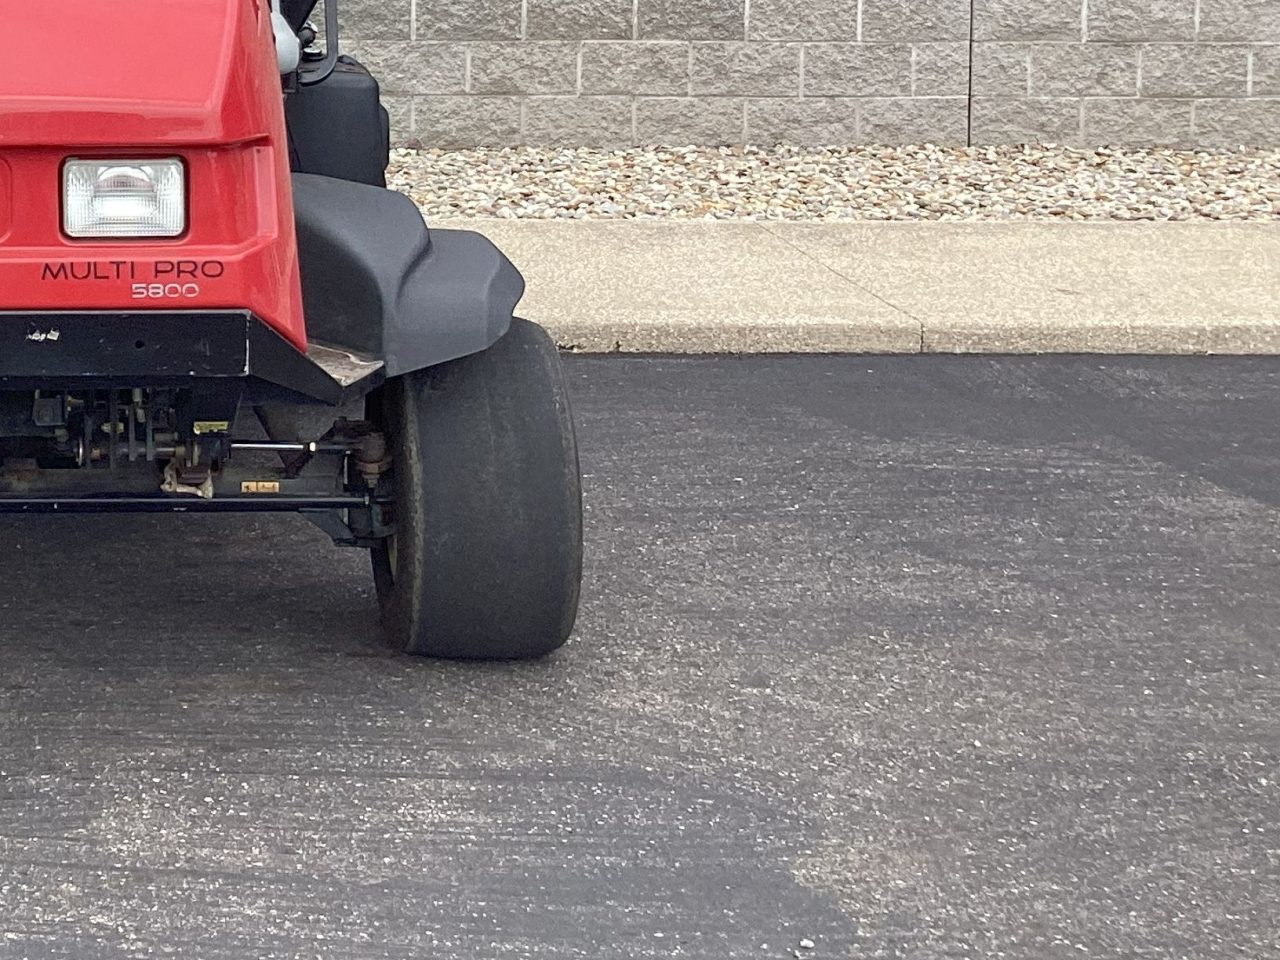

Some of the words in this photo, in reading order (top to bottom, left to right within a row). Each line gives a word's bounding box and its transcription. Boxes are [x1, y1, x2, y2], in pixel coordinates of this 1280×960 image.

[41, 260, 135, 281] MULTI
[155, 260, 224, 279] PRO
[131, 283, 200, 299] 5800
